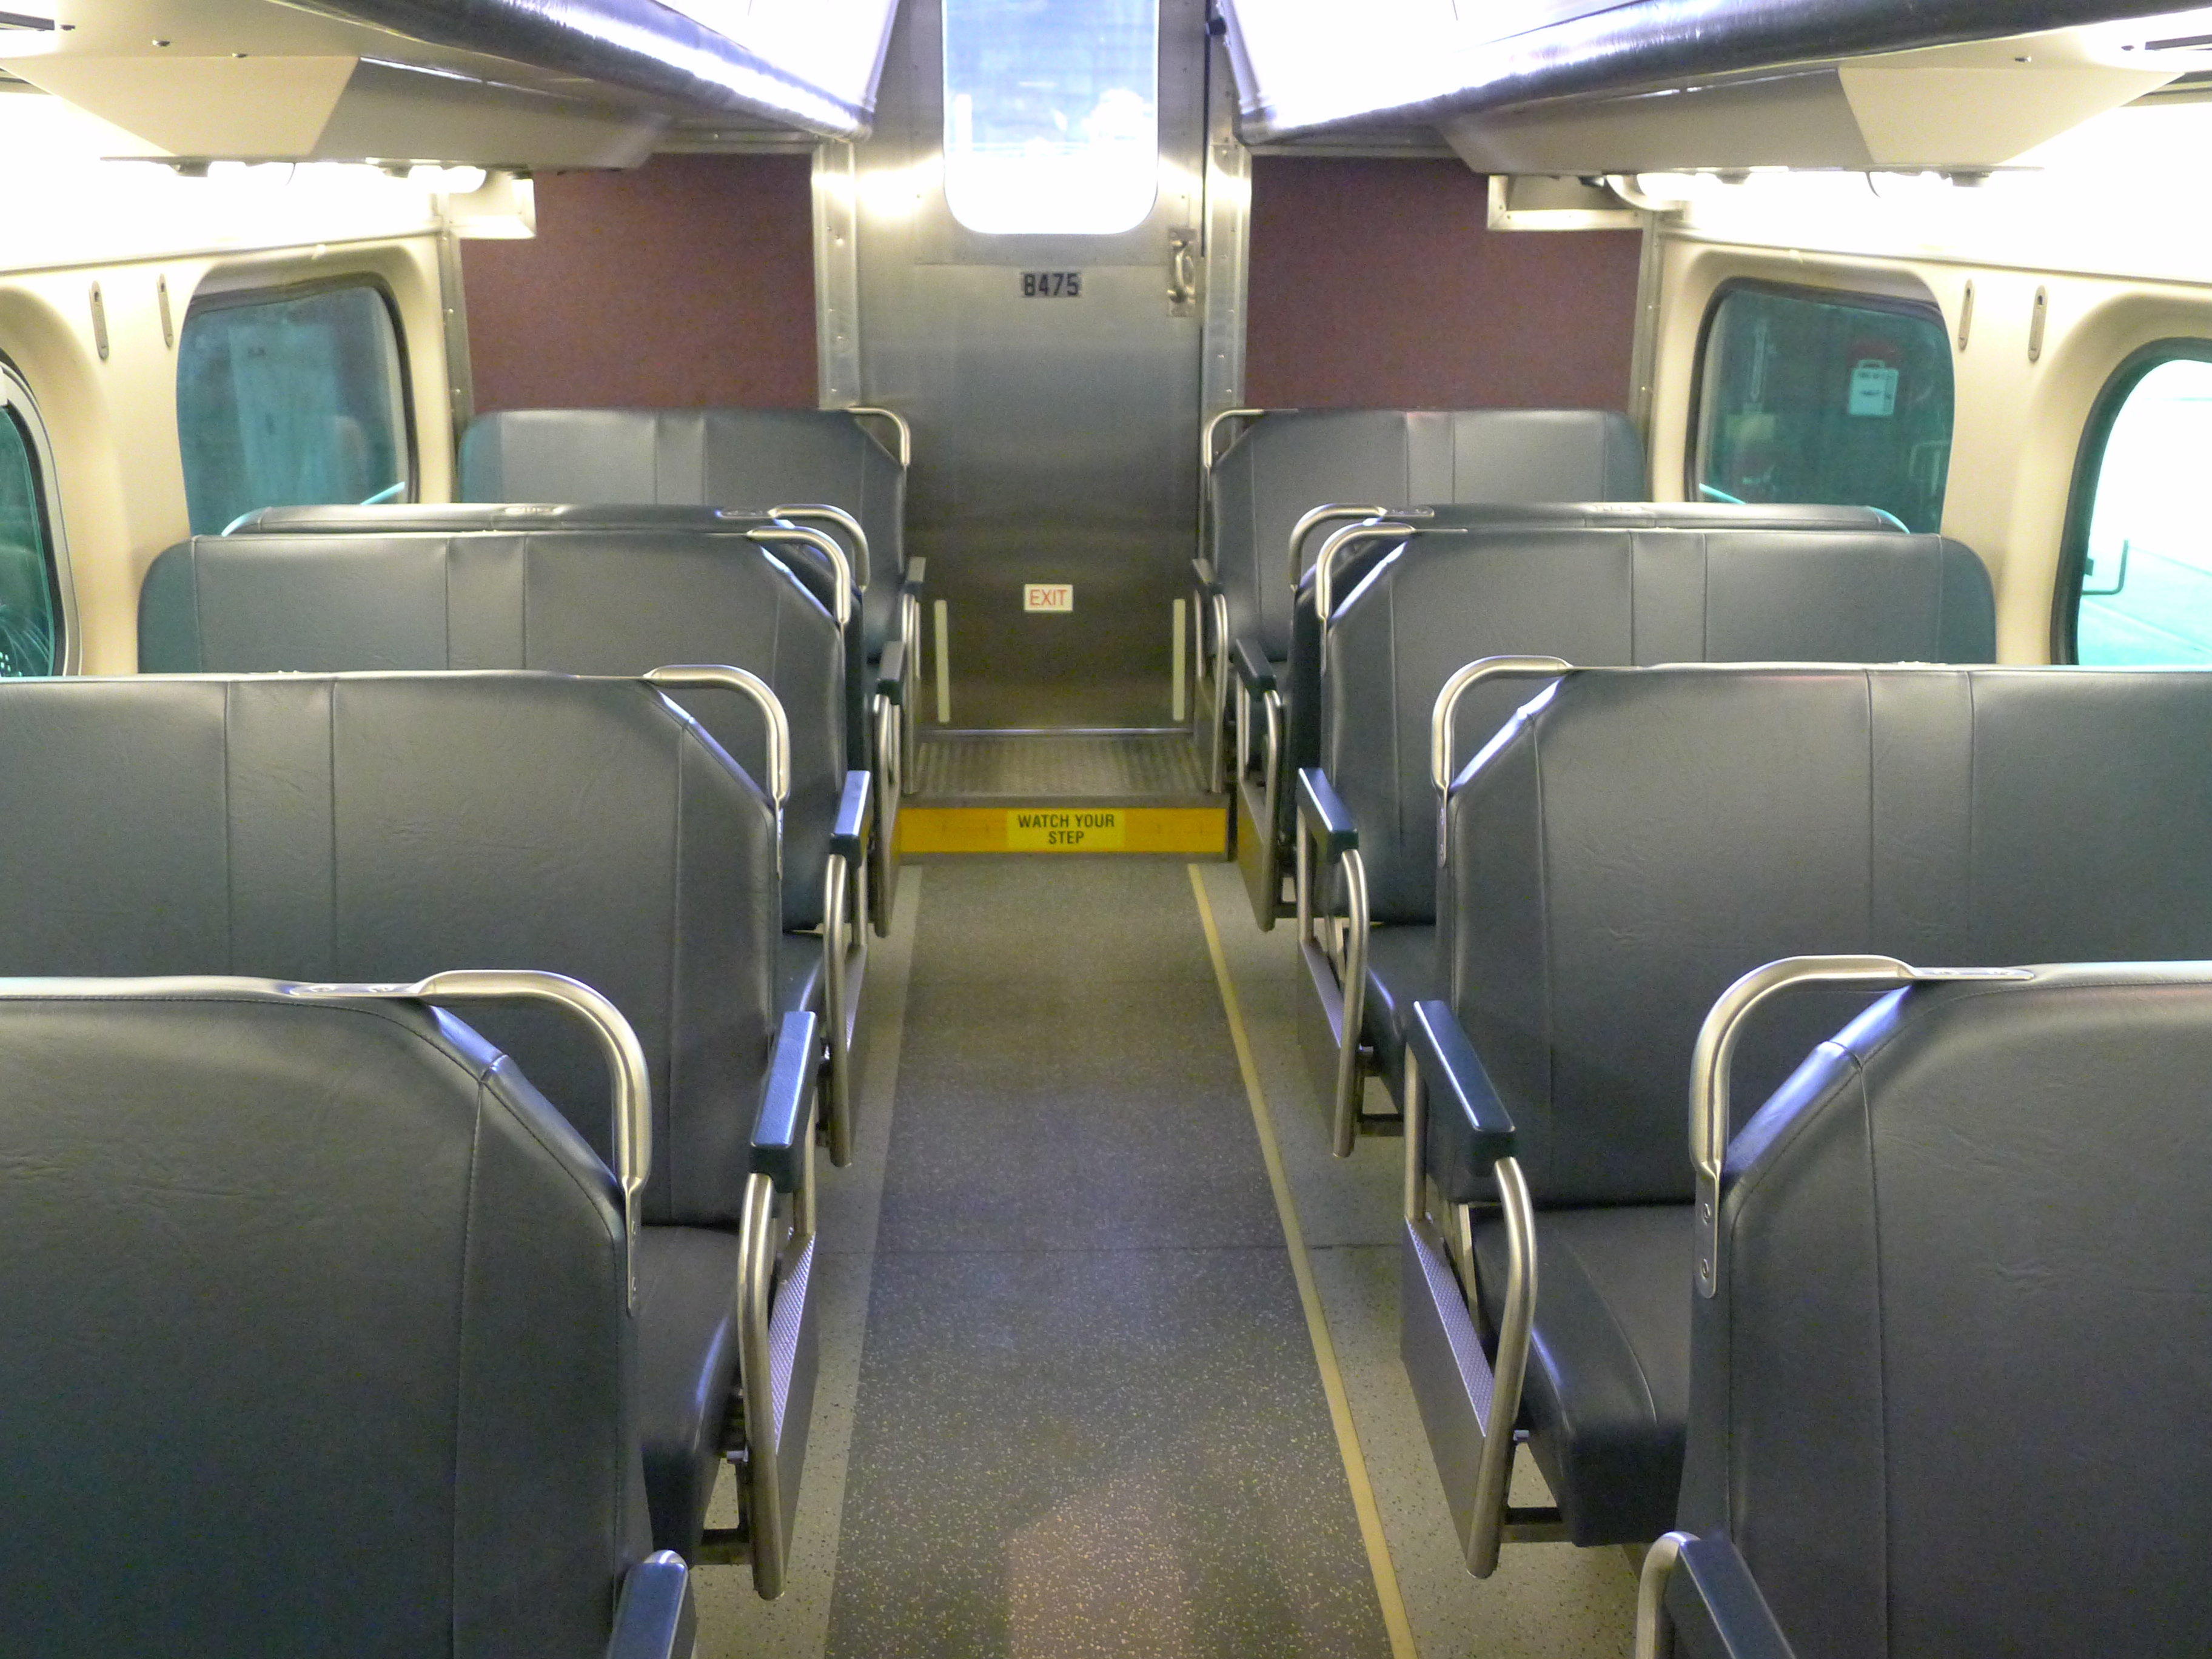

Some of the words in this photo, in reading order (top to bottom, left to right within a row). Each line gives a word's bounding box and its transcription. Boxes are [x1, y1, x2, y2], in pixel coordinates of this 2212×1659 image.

[1024, 273, 1079, 296] 8475
[1030, 589, 1067, 606] EXIT
[1017, 814, 1069, 828] WATCH
[1075, 814, 1114, 828] YOUR
[1048, 831, 1084, 844] STEP
